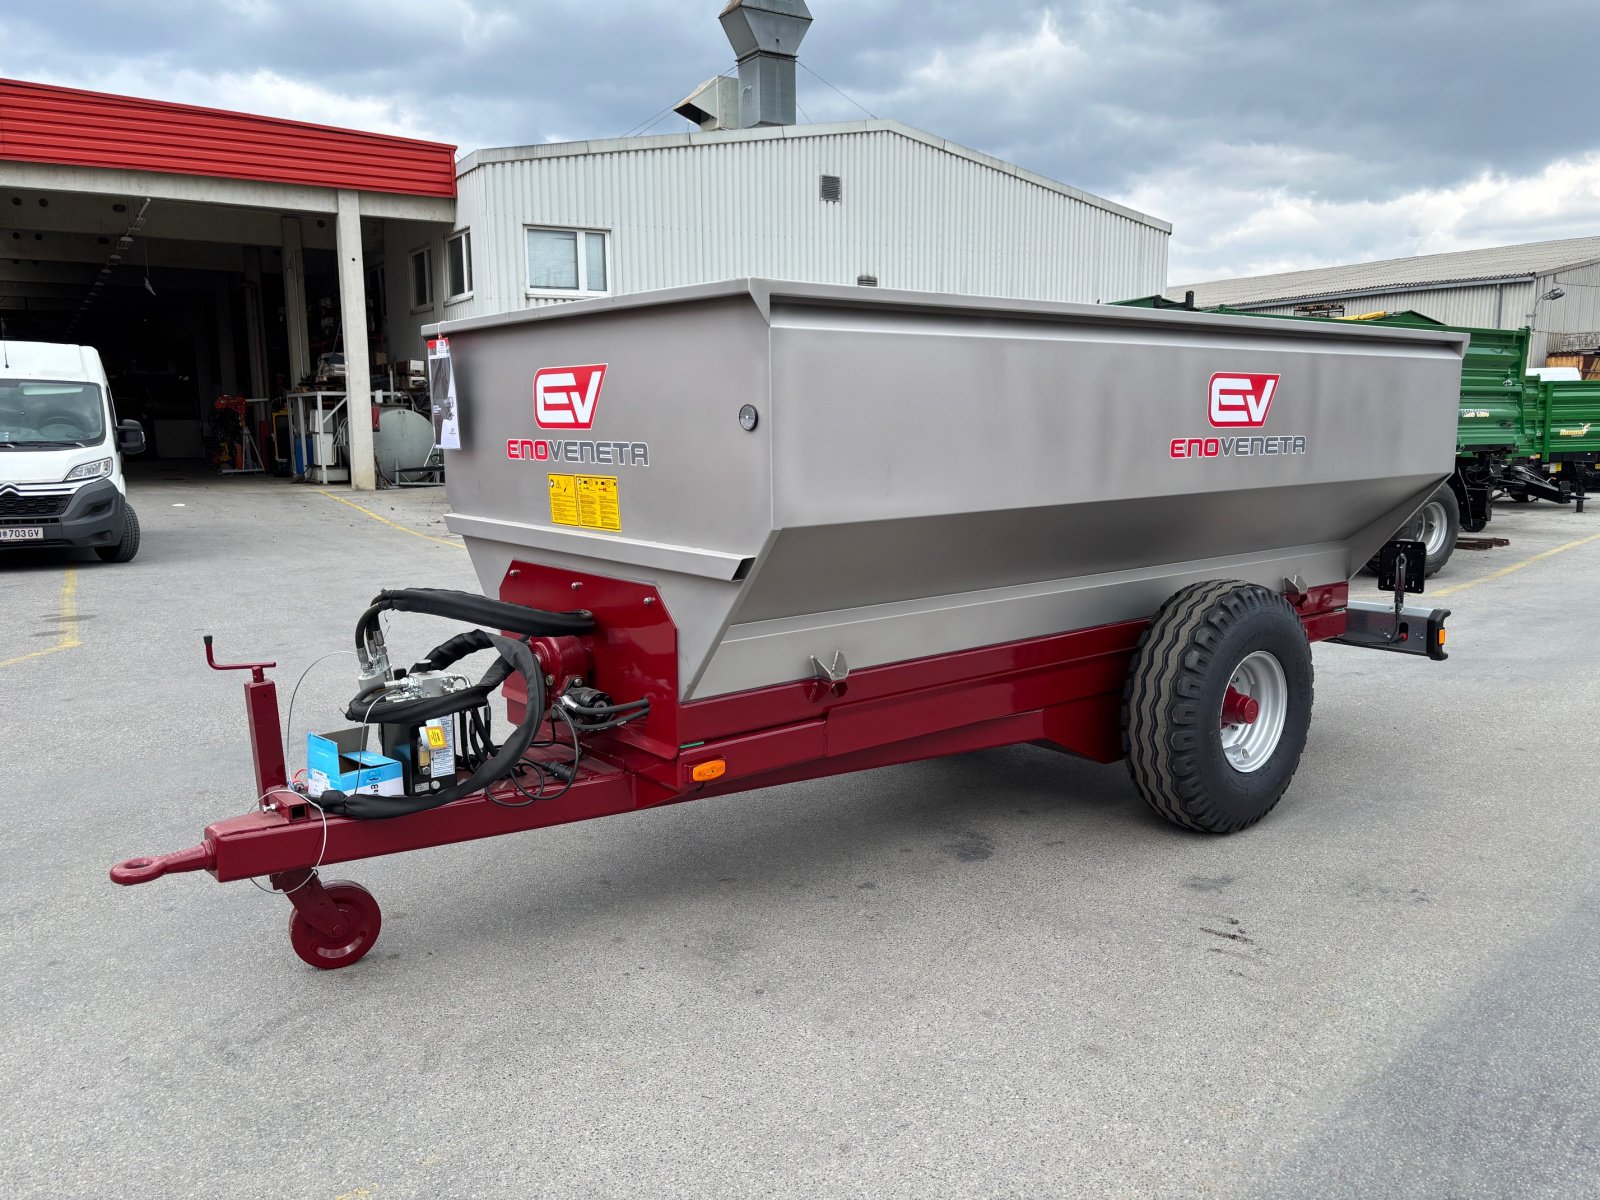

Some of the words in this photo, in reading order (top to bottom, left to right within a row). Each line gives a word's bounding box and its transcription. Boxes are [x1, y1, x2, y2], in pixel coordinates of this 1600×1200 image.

[536, 371, 602, 424] EV
[1211, 377, 1276, 423] EV
[507, 438, 650, 467] ENOVENETA
[1170, 435, 1307, 459] ENOVENETA
